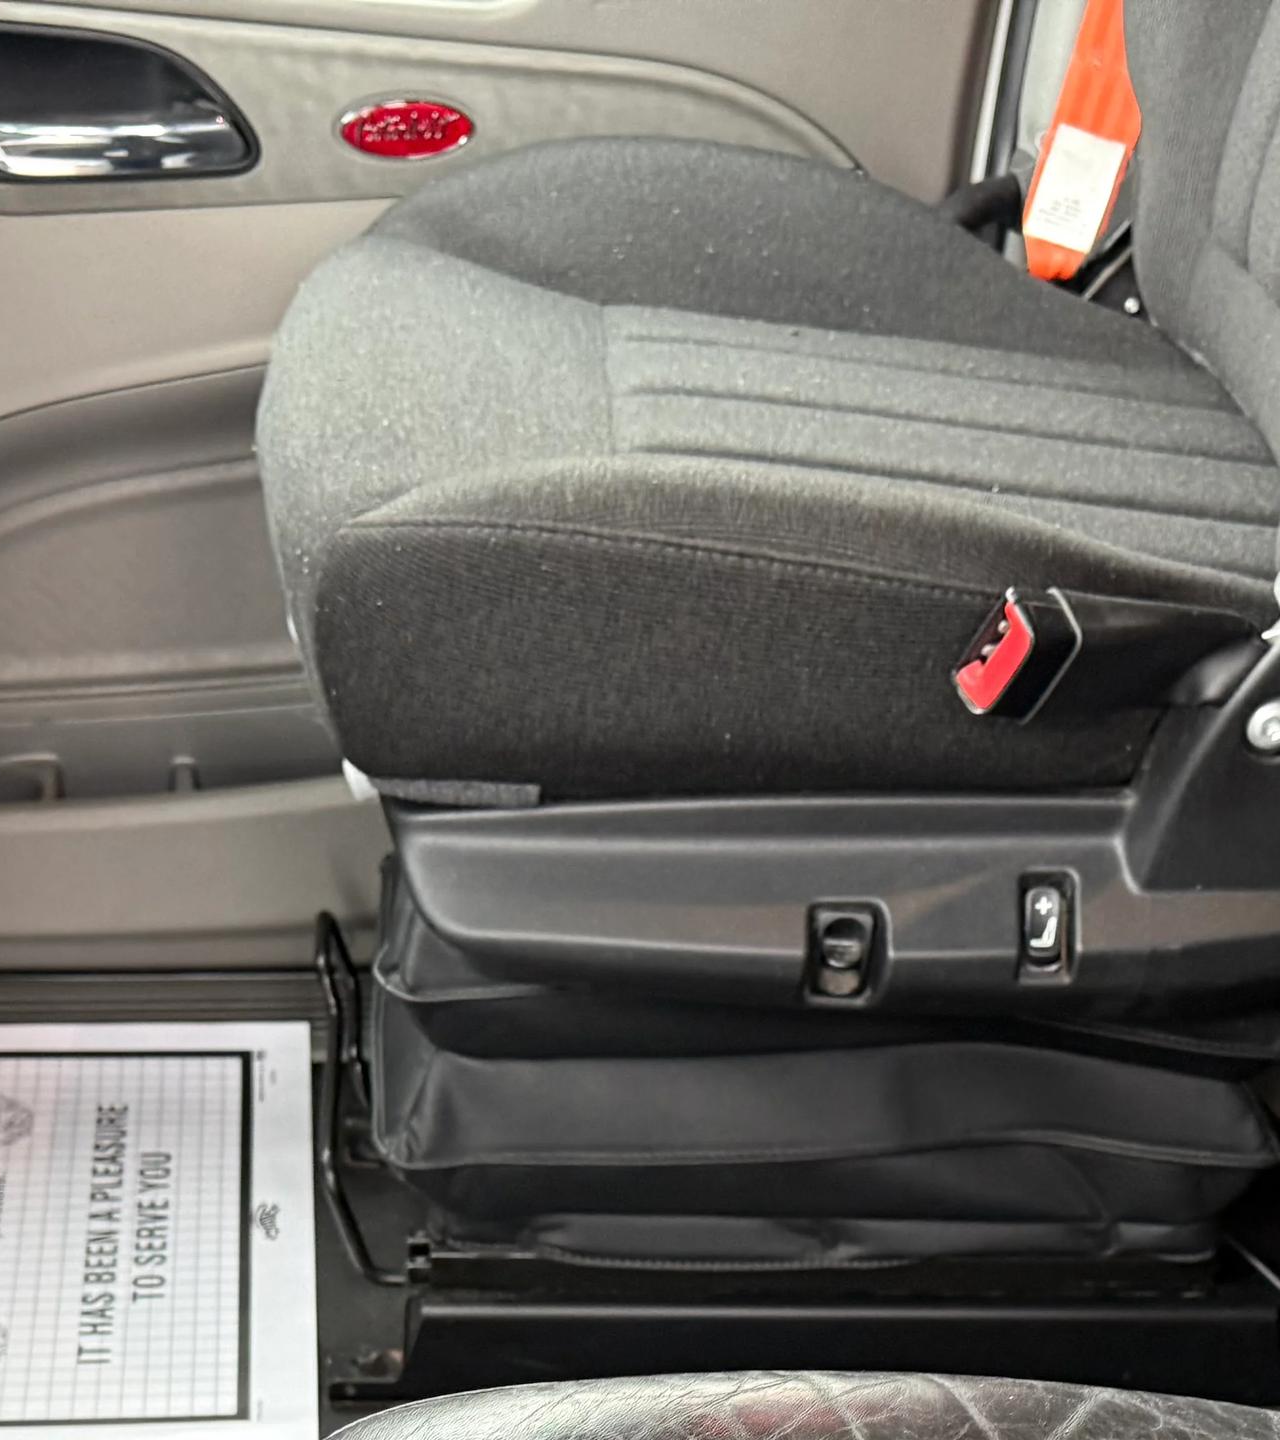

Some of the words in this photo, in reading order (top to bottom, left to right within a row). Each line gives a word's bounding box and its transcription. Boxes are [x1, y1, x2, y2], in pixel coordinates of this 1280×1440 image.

[90, 1103, 129, 1203] PLEASURE
[138, 1152, 172, 1194] YOU
[88, 1208, 120, 1223] A
[134, 1200, 169, 1267] SERVE
[84, 1229, 120, 1284] BEEN
[132, 1274, 166, 1303] TO
[78, 1292, 115, 1336] HAS
[77, 1346, 112, 1365] IT
